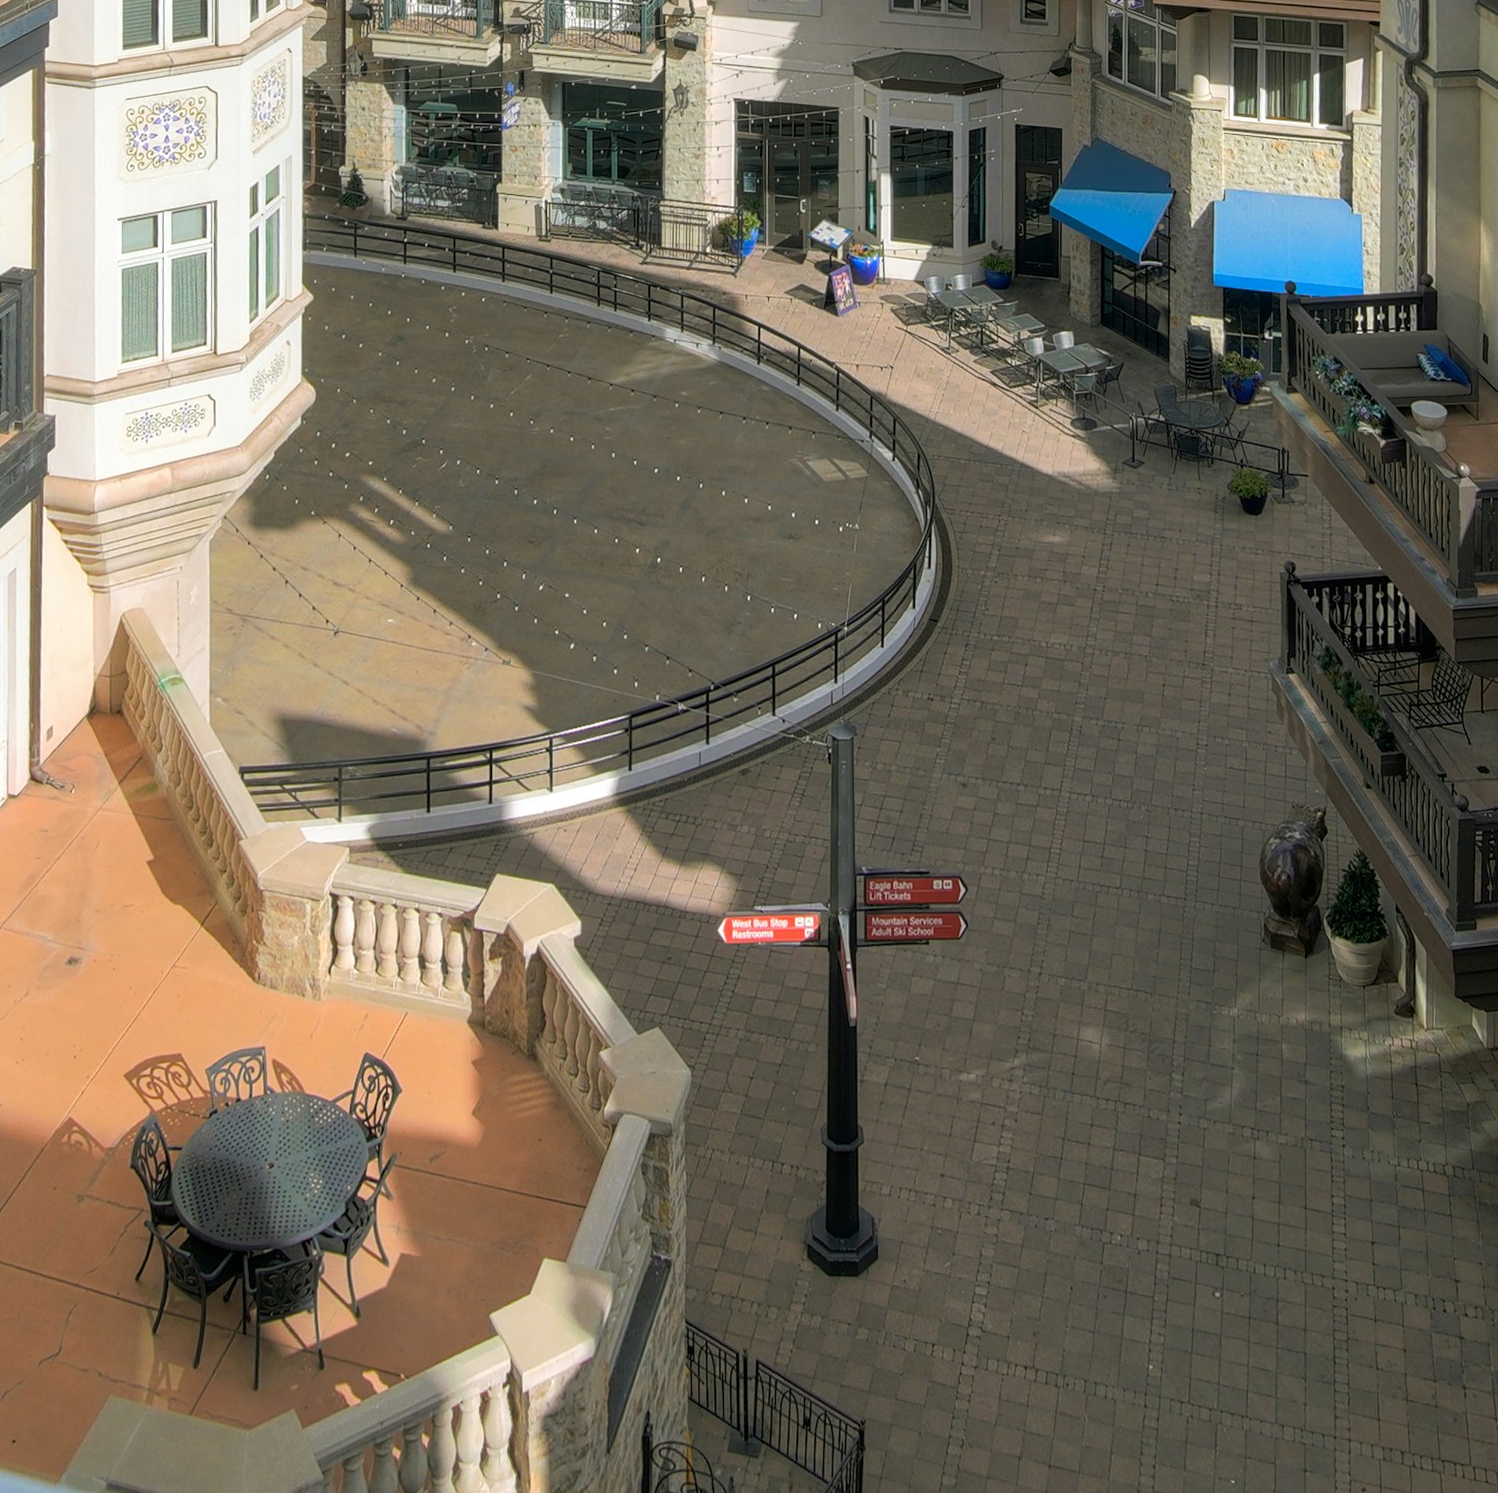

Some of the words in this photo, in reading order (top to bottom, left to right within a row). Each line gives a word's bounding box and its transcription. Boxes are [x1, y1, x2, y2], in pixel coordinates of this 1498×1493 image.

[869, 881, 891, 892] Eagle
[893, 881, 913, 890] Bahn
[869, 892, 882, 900] Lift
[883, 892, 911, 900] Tickets
[731, 919, 752, 928] West
[753, 919, 768, 927] Bus
[770, 918, 788, 928] Stop
[871, 917, 908, 925] Mountain
[909, 917, 943, 925] Services
[731, 930, 774, 939] Restrooms
[871, 927, 892, 936] Adult
[894, 927, 906, 936] Ski
[907, 927, 934, 936] School
